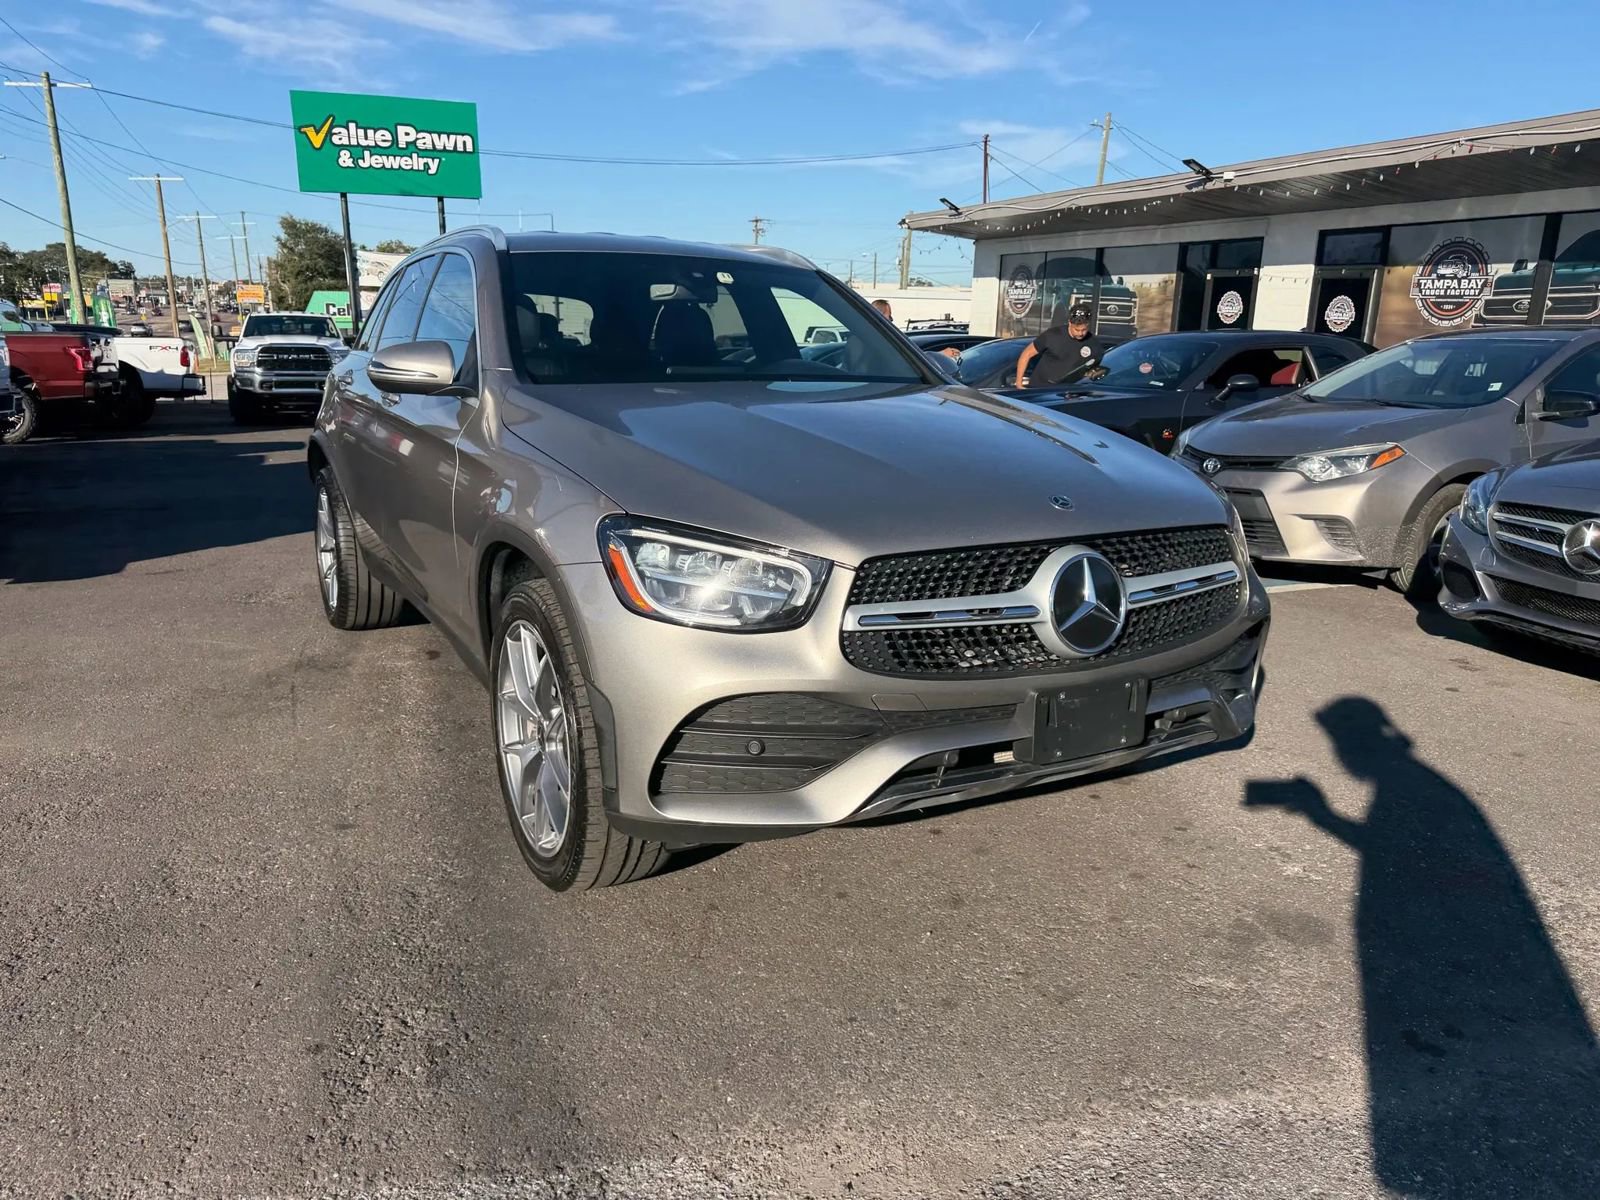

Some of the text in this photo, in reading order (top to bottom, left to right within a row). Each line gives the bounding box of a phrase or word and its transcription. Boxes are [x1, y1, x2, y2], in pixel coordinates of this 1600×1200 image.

[396, 125, 473, 152] Pawn
[338, 150, 440, 175] & Jewelry
[1419, 279, 1485, 289] TAMPA BAY
